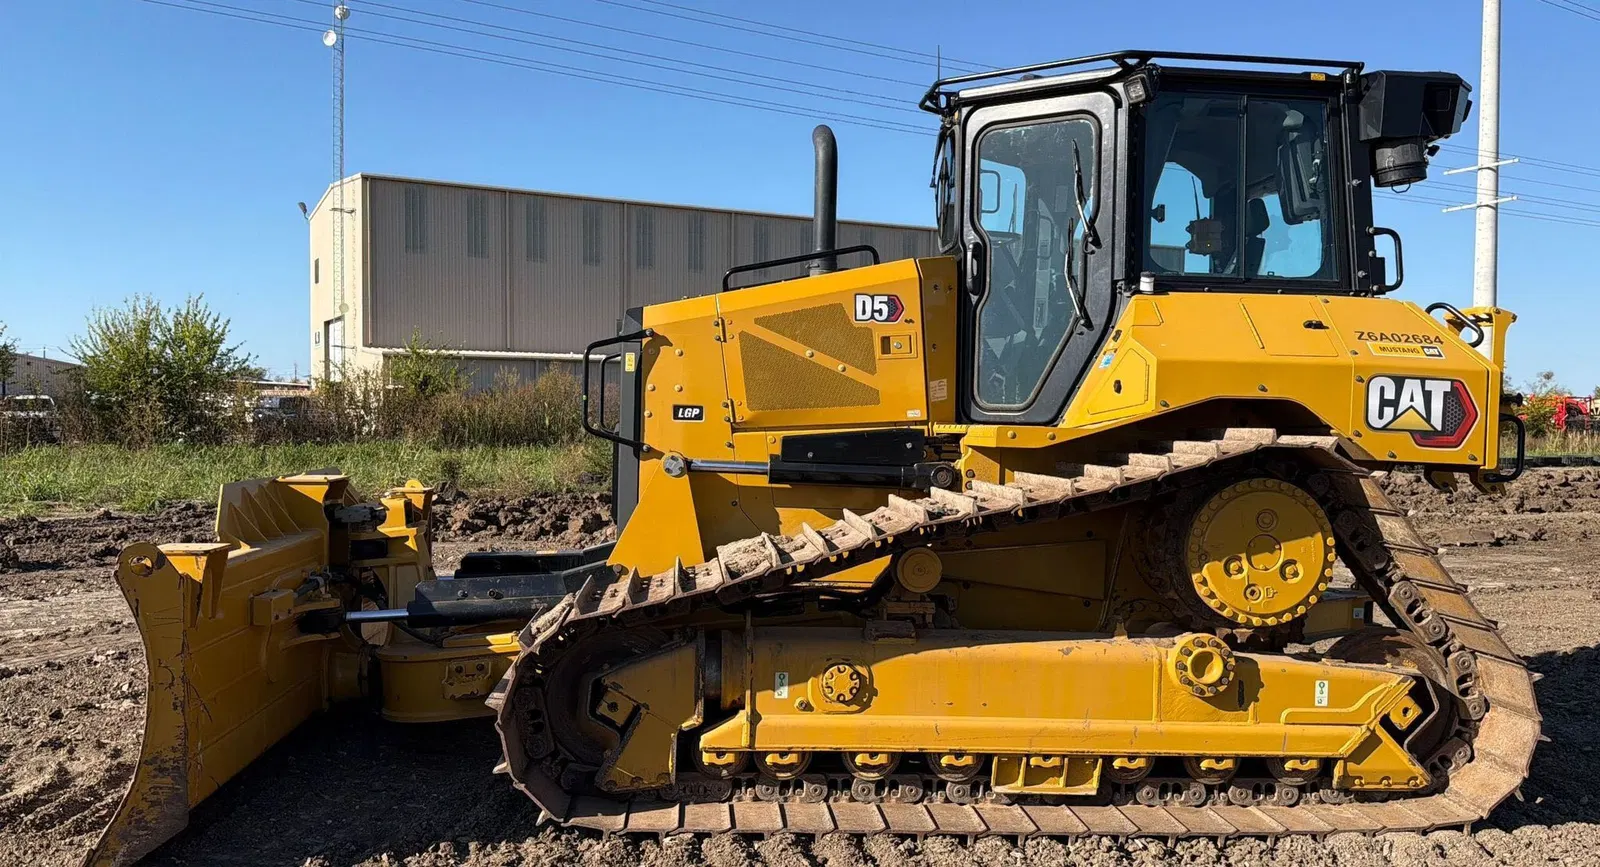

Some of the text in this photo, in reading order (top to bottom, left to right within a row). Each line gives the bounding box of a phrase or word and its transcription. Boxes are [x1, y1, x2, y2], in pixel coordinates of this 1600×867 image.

[855, 294, 889, 321] D5
[1354, 330, 1444, 345] Z6A02684
[1378, 346, 1420, 354] MUSTANG
[1367, 376, 1452, 432] CAT
[677, 407, 700, 418] LGP
